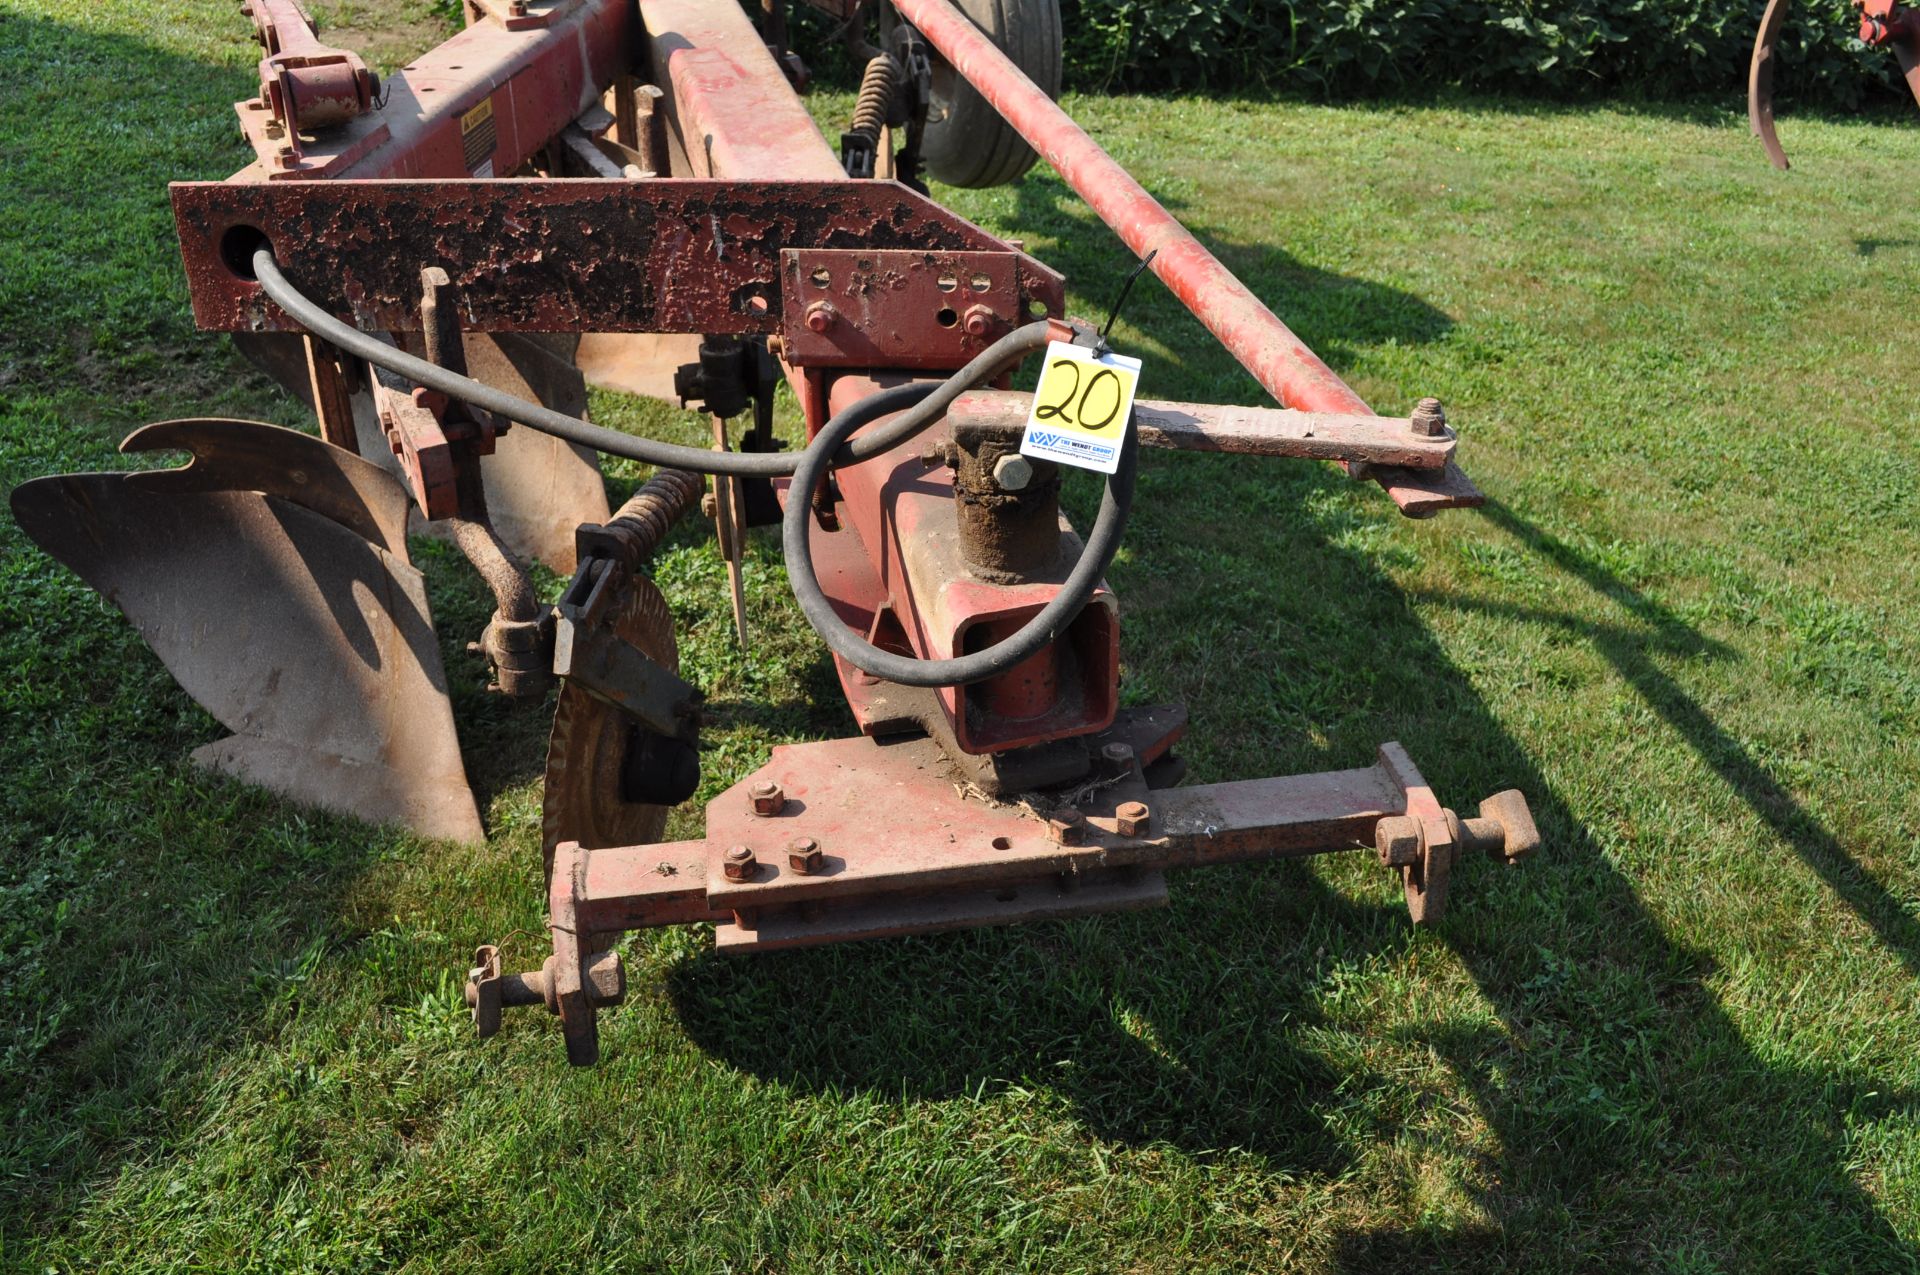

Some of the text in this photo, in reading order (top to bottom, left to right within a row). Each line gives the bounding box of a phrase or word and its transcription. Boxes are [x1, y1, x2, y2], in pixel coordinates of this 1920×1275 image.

[1036, 359, 1121, 430] 20
[1031, 445, 1107, 464] www.thewendtgroup.com
[1061, 438, 1071, 447] THE
[1071, 441, 1092, 452] WENDT
[1092, 446, 1112, 455] GROUP
